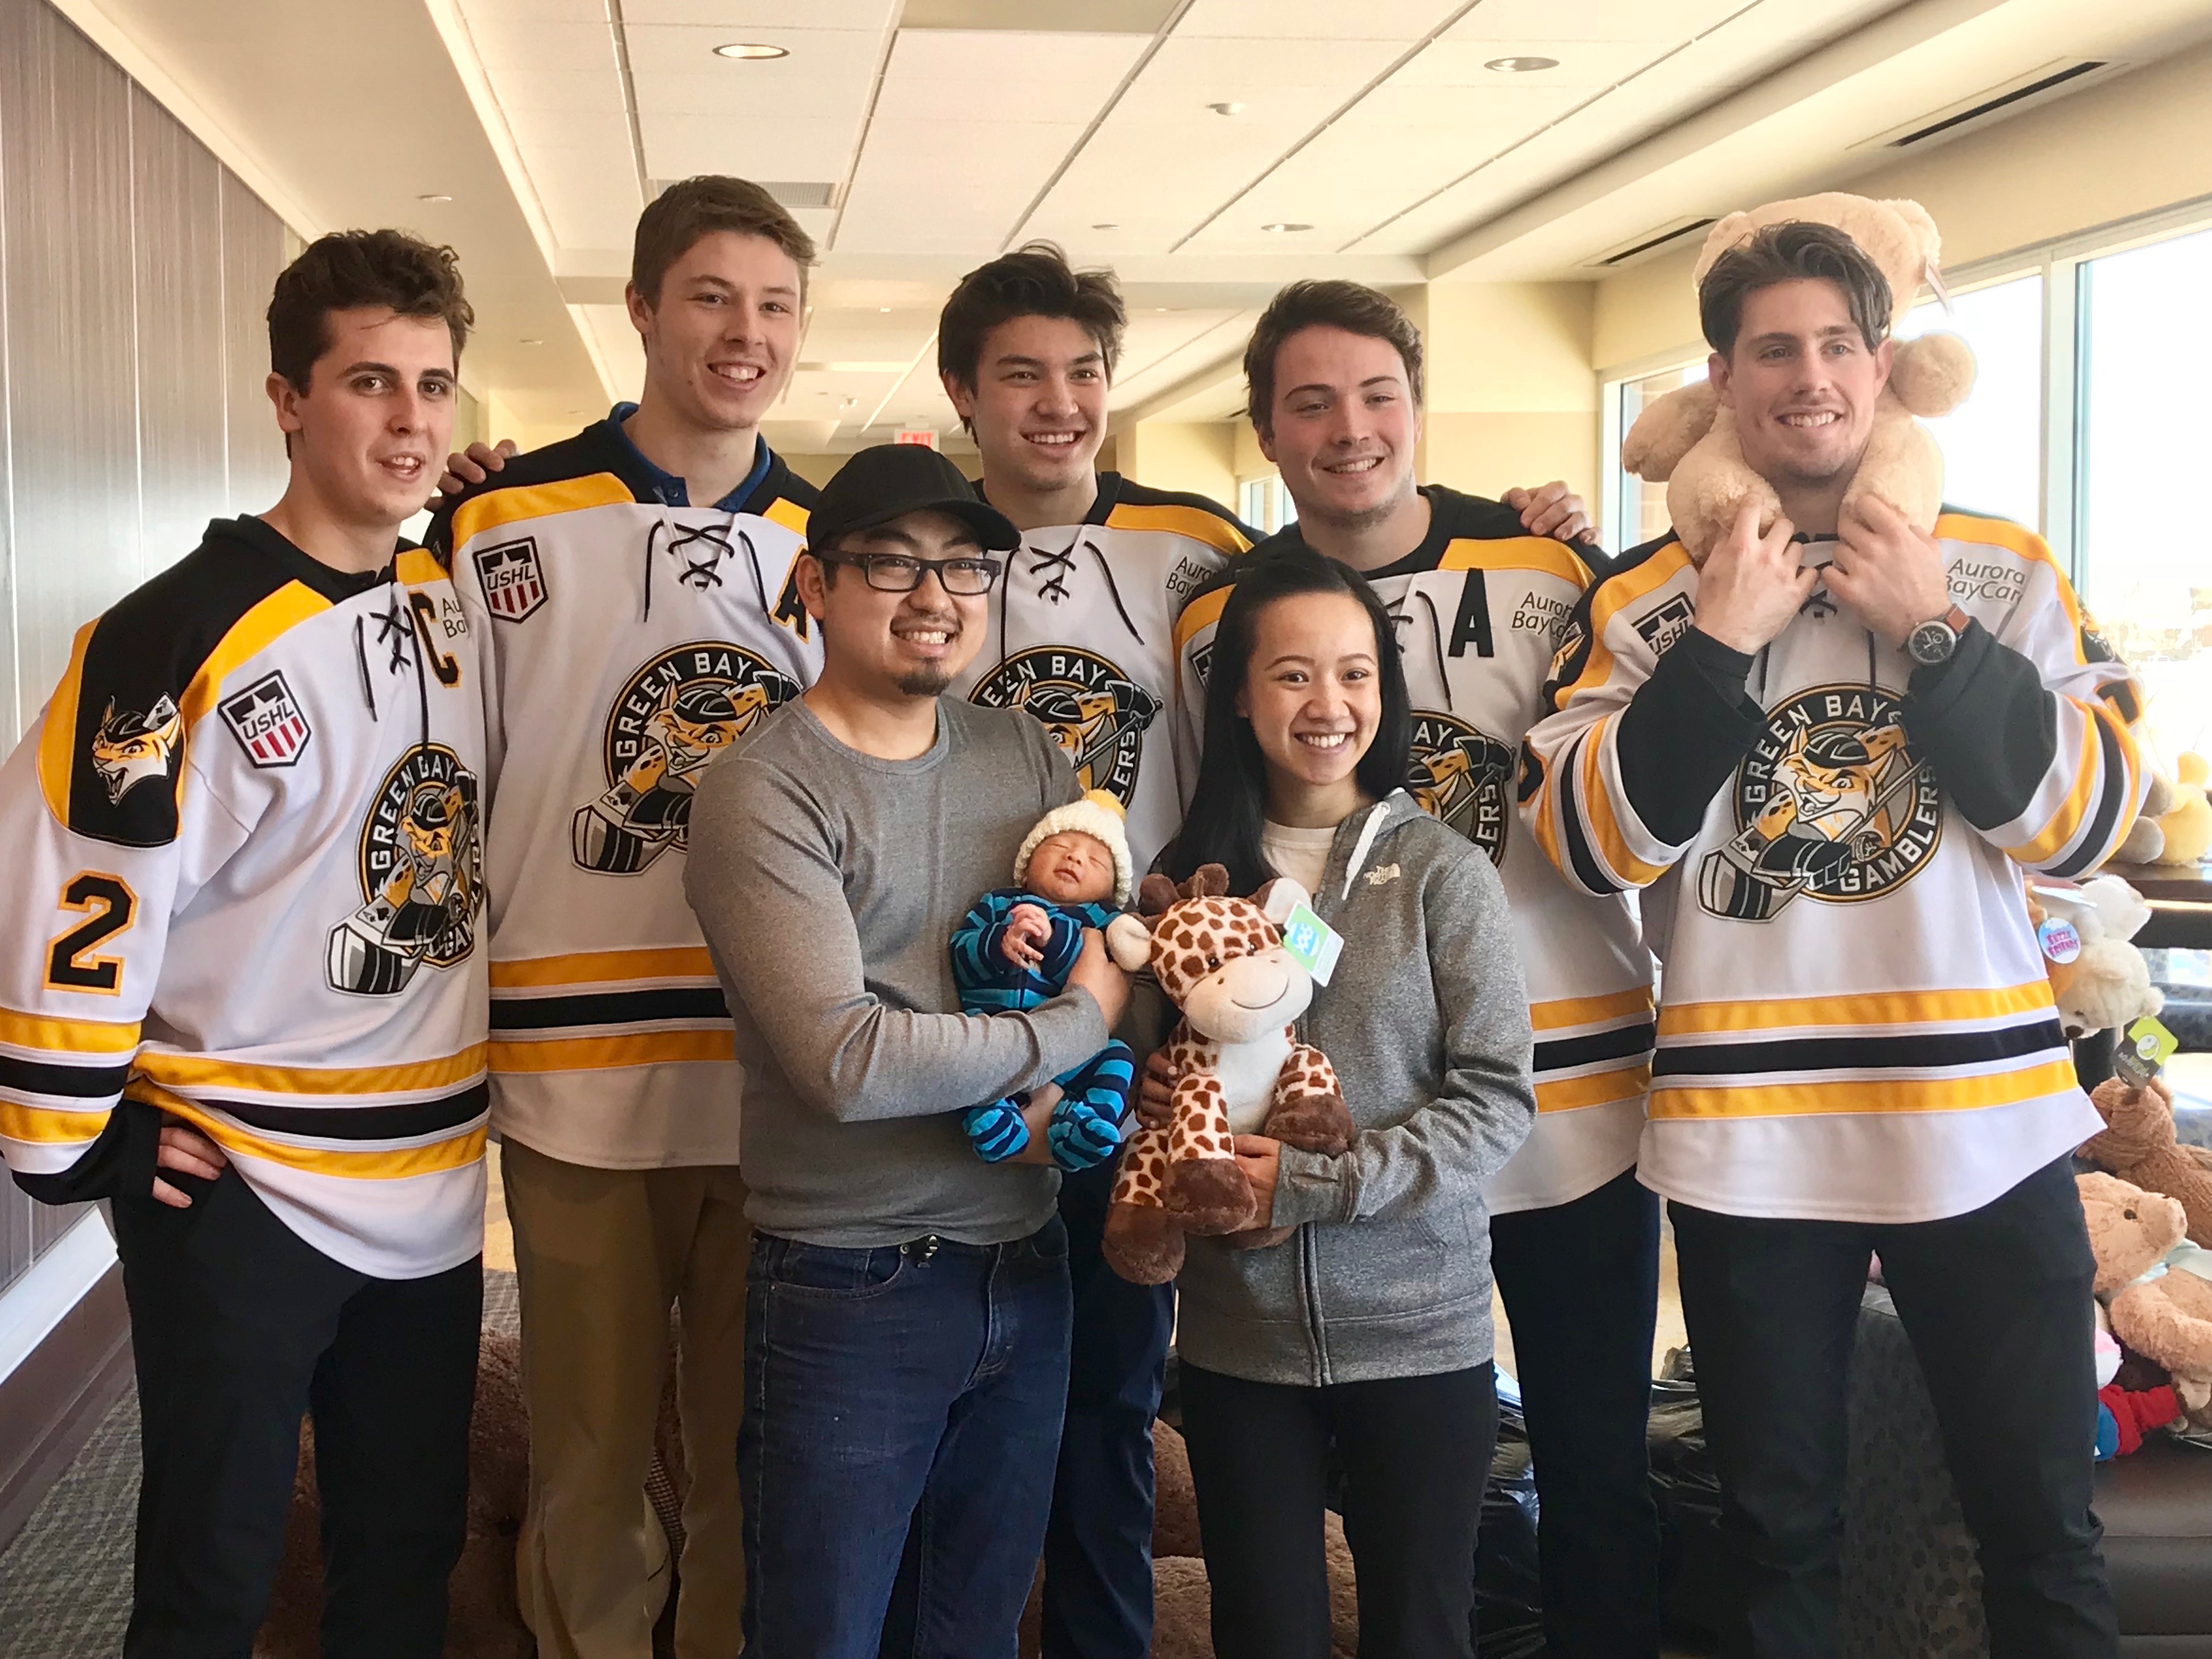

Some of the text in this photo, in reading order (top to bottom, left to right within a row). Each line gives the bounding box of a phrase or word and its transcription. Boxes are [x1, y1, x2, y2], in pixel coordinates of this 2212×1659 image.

[487, 565, 535, 590] USHL
[1175, 556, 1212, 582] Auro
[1948, 558, 2026, 585] Aurora
[1447, 567, 1494, 658] A
[1511, 610, 1565, 637] BayCa
[1520, 591, 1573, 618] Auror
[408, 589, 462, 689] C
[616, 652, 752, 758] GREEN BAY
[981, 655, 1107, 707] EEN BAY
[242, 701, 295, 740] USHL
[1413, 721, 1453, 747] AY
[1745, 694, 1888, 803] GREEN BAY
[371, 765, 415, 870] GREEN
[1839, 765, 1938, 893] GAMBLERS
[41, 869, 139, 997] 2
